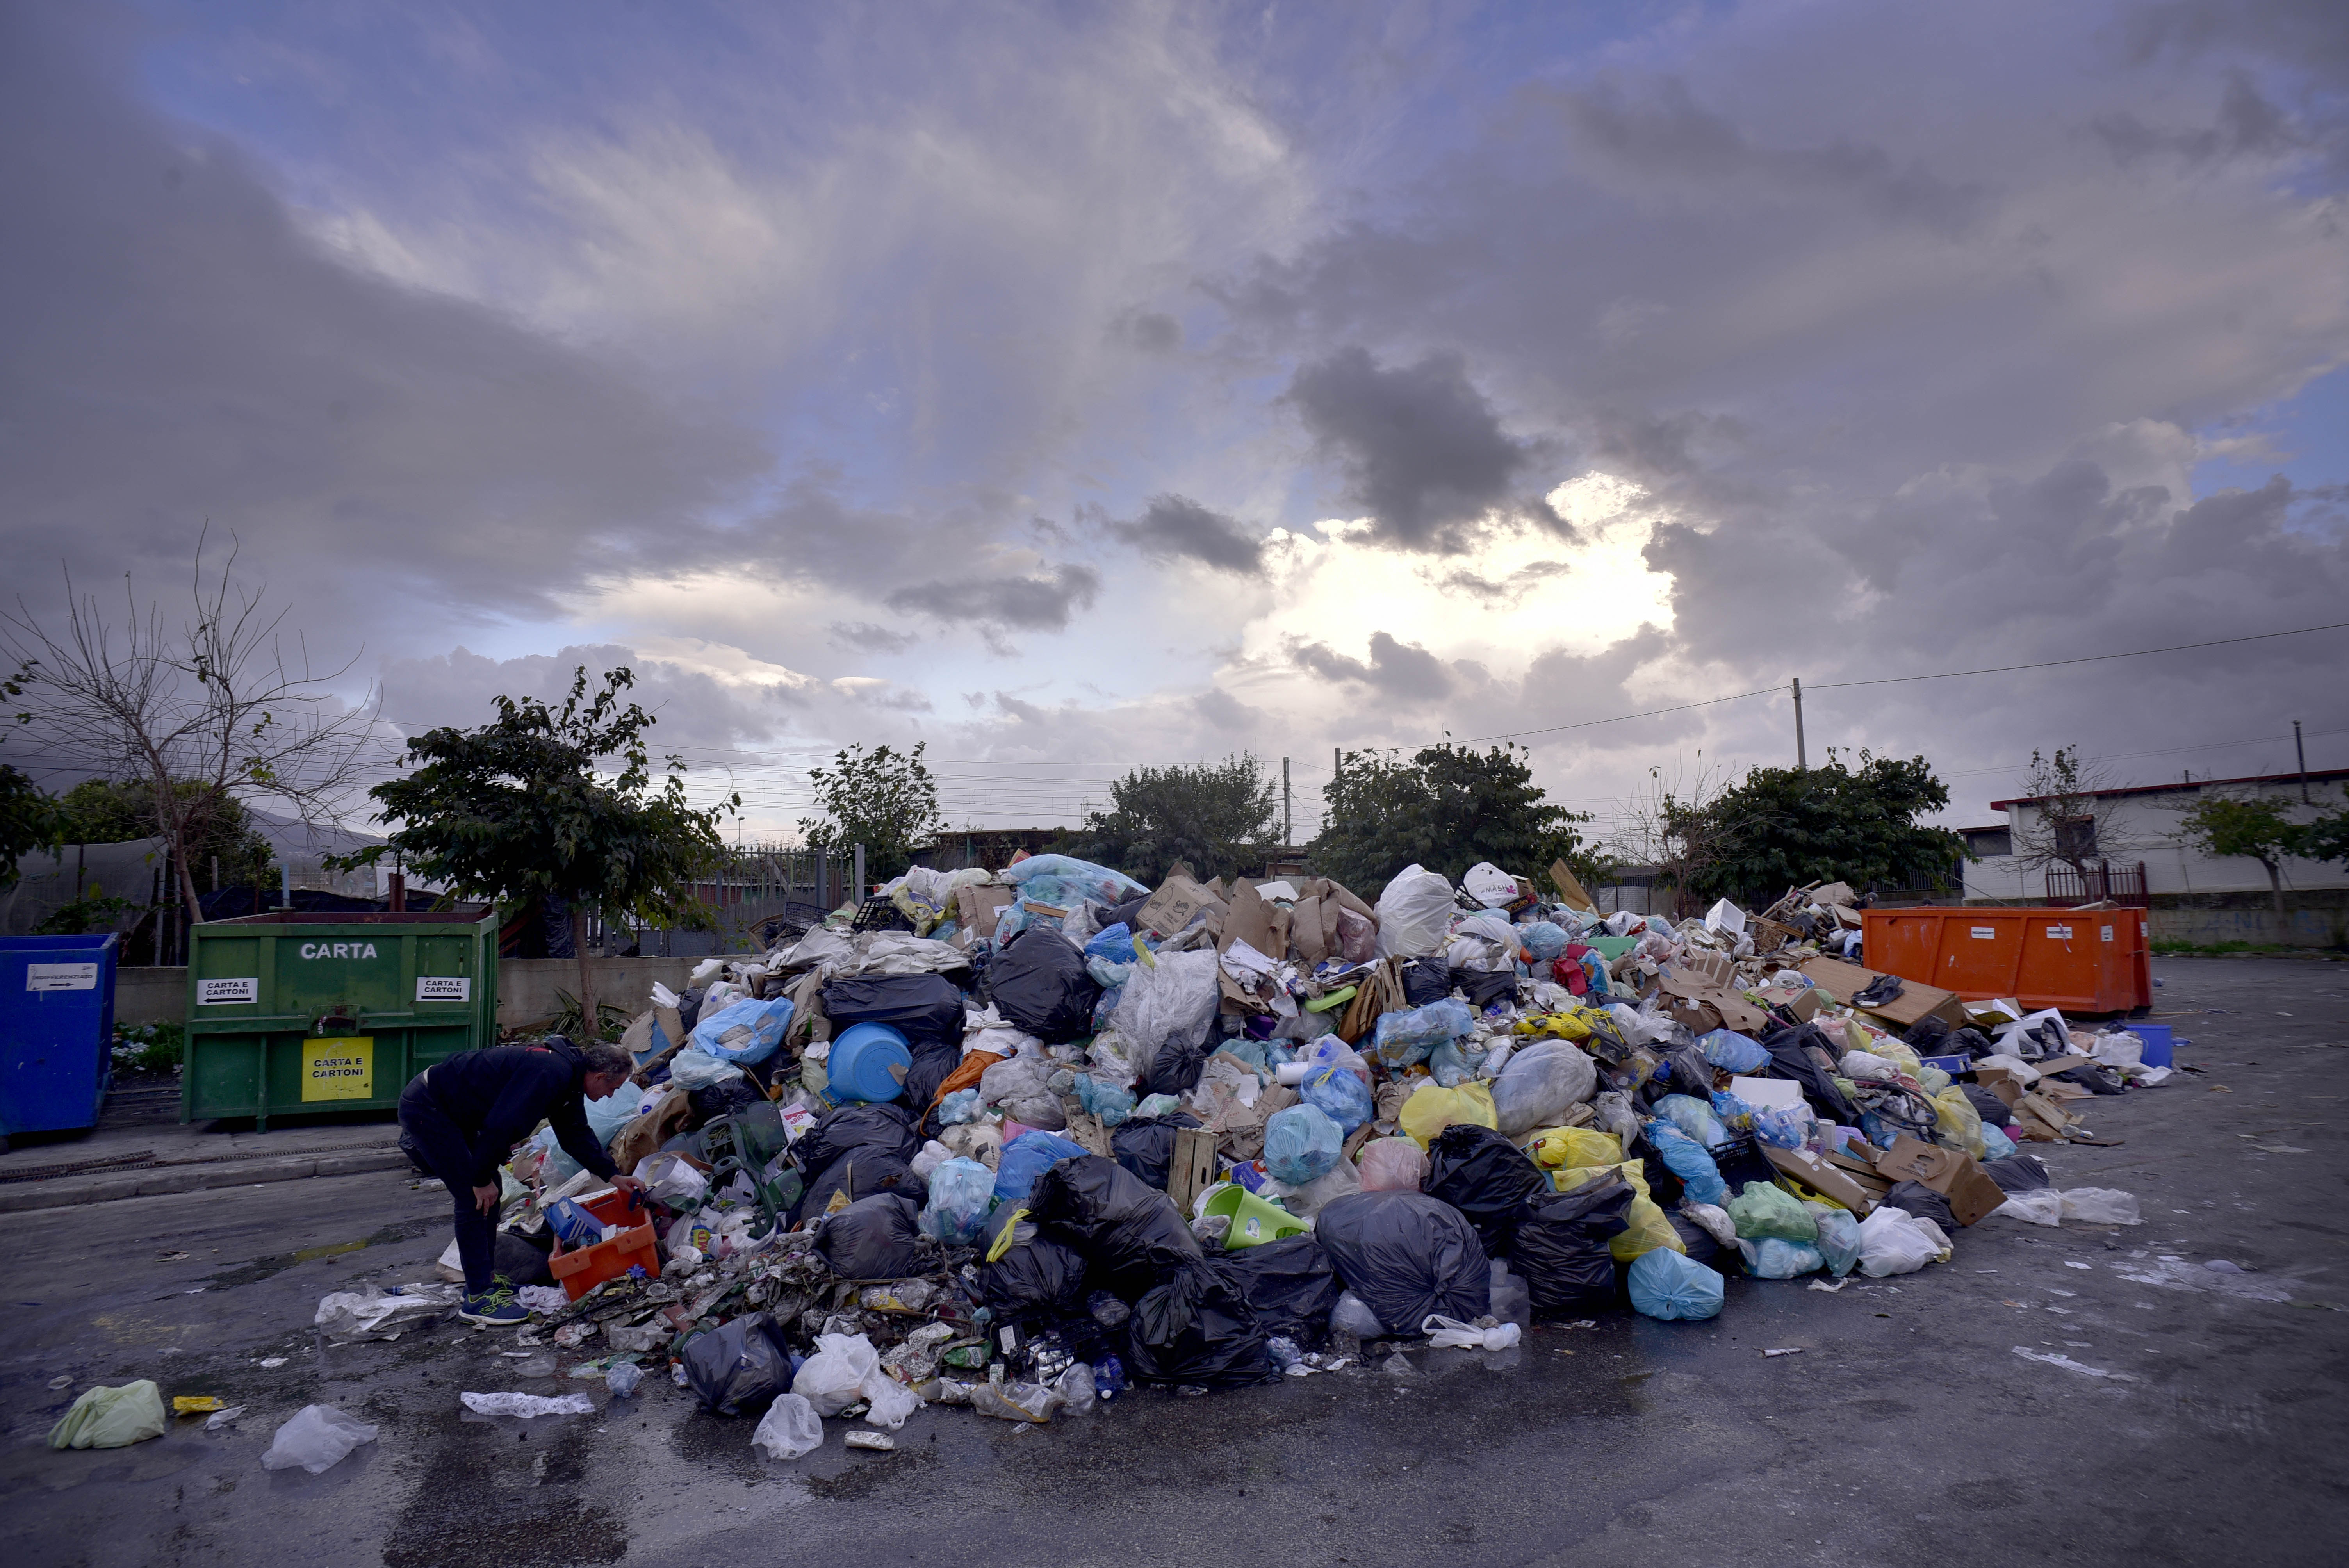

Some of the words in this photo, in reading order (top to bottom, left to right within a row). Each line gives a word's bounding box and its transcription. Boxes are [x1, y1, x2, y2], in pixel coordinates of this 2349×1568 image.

[1173, 900, 1190, 909] Svelto
[301, 943, 378, 959] CARTA
[314, 1058, 352, 1067] CARTA
[312, 1069, 363, 1078] CARTONI
